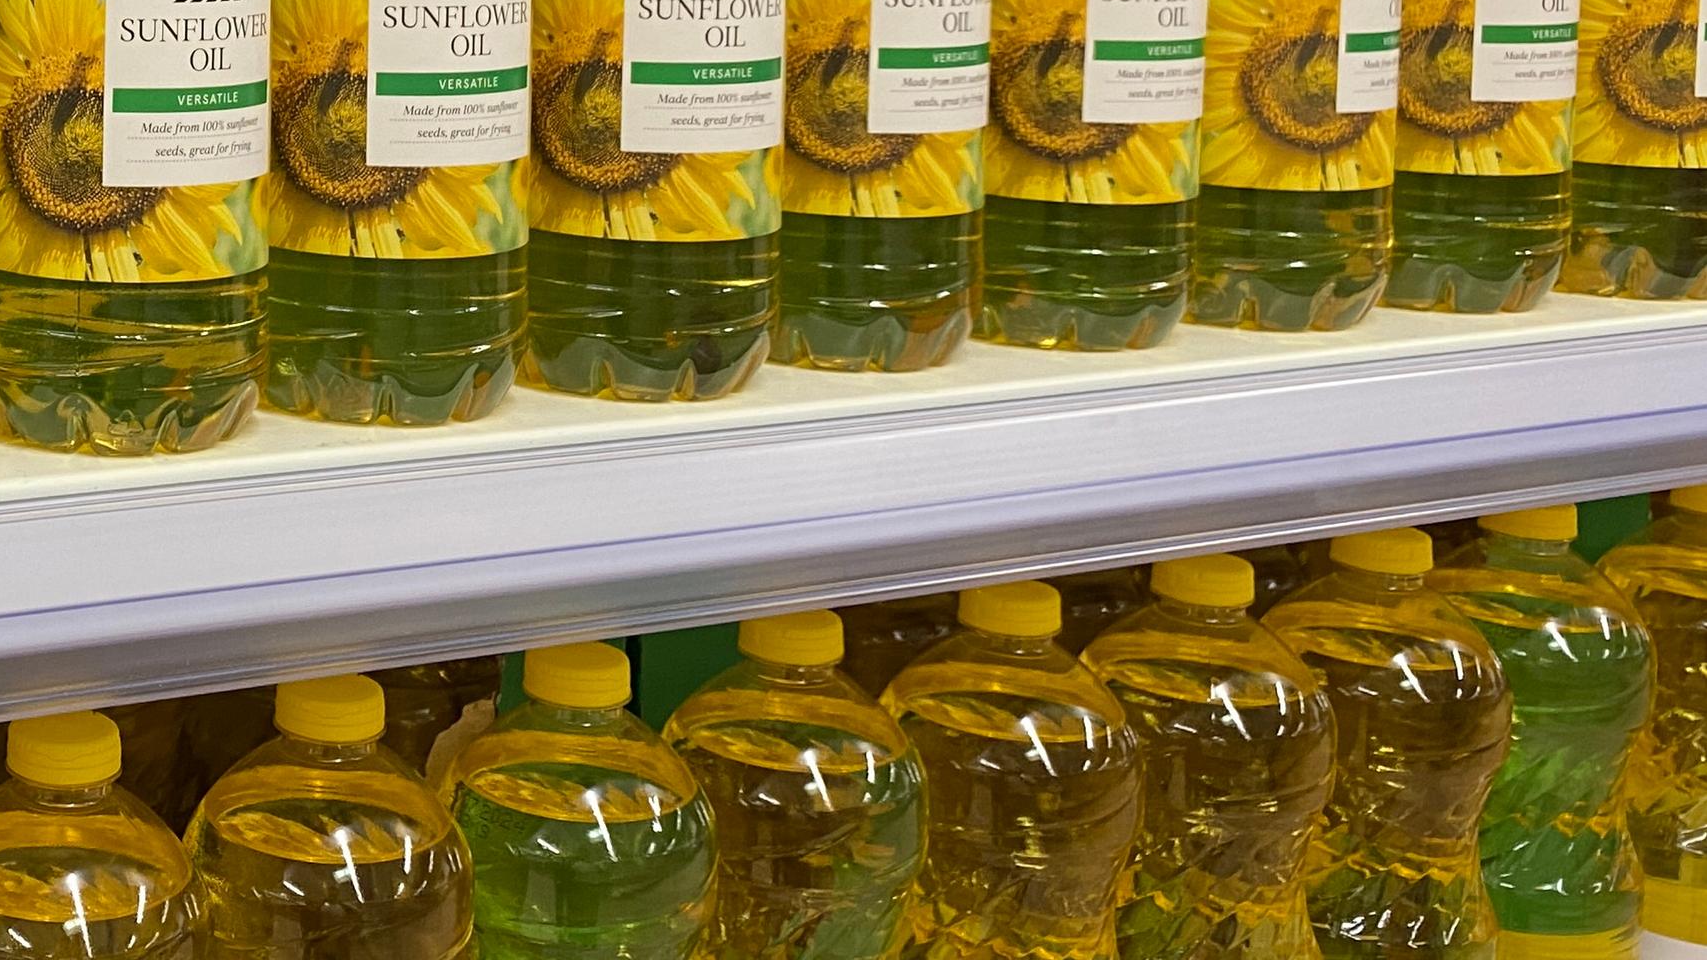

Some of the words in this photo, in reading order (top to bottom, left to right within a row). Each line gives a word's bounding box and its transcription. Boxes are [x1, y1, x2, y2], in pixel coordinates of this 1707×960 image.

[383, 1, 528, 29] SUNFLOWER
[942, 11, 973, 33] OIL
[1158, 7, 1189, 27] OIL
[120, 12, 267, 42] SUNFLOWER
[1533, 29, 1571, 39] VERSATILE
[705, 26, 746, 48] OIL
[451, 34, 491, 57] OIL
[190, 47, 231, 72] OIL
[693, 67, 752, 79] VERSATILE
[439, 76, 498, 89] VERSATILE
[178, 92, 238, 105] VERSATILE
[658, 93, 689, 104] Made
[690, 92, 714, 106] from
[403, 105, 434, 116] Made
[435, 104, 461, 118] from
[463, 103, 485, 115] 100%
[141, 122, 172, 134] Made
[173, 120, 199, 136] from
[202, 119, 224, 131] 100%
[704, 114, 728, 127] great
[450, 126, 474, 139] great
[475, 124, 490, 137] for
[155, 145, 186, 157] seeds,
[189, 144, 214, 158] great
[215, 142, 229, 156] for
